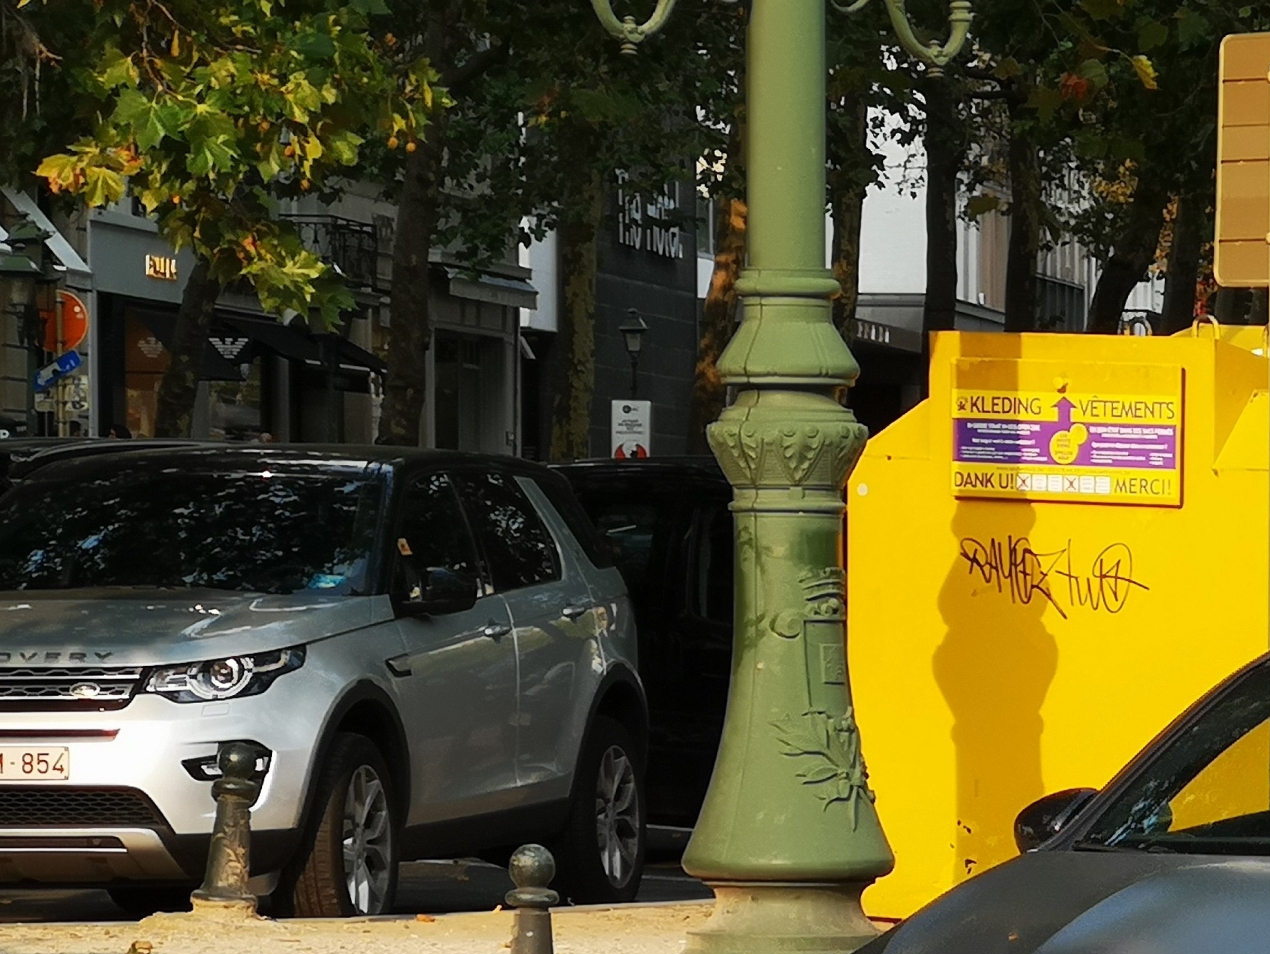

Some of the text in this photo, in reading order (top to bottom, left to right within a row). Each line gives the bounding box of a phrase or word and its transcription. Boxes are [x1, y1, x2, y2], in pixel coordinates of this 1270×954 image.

[970, 395, 1175, 420] KLEDING VÊTEMENTS
[954, 471, 995, 489] DANK
[998, 472, 1015, 490] U!
[1114, 477, 1172, 496] MERCI!
[0, 752, 65, 775] -854
